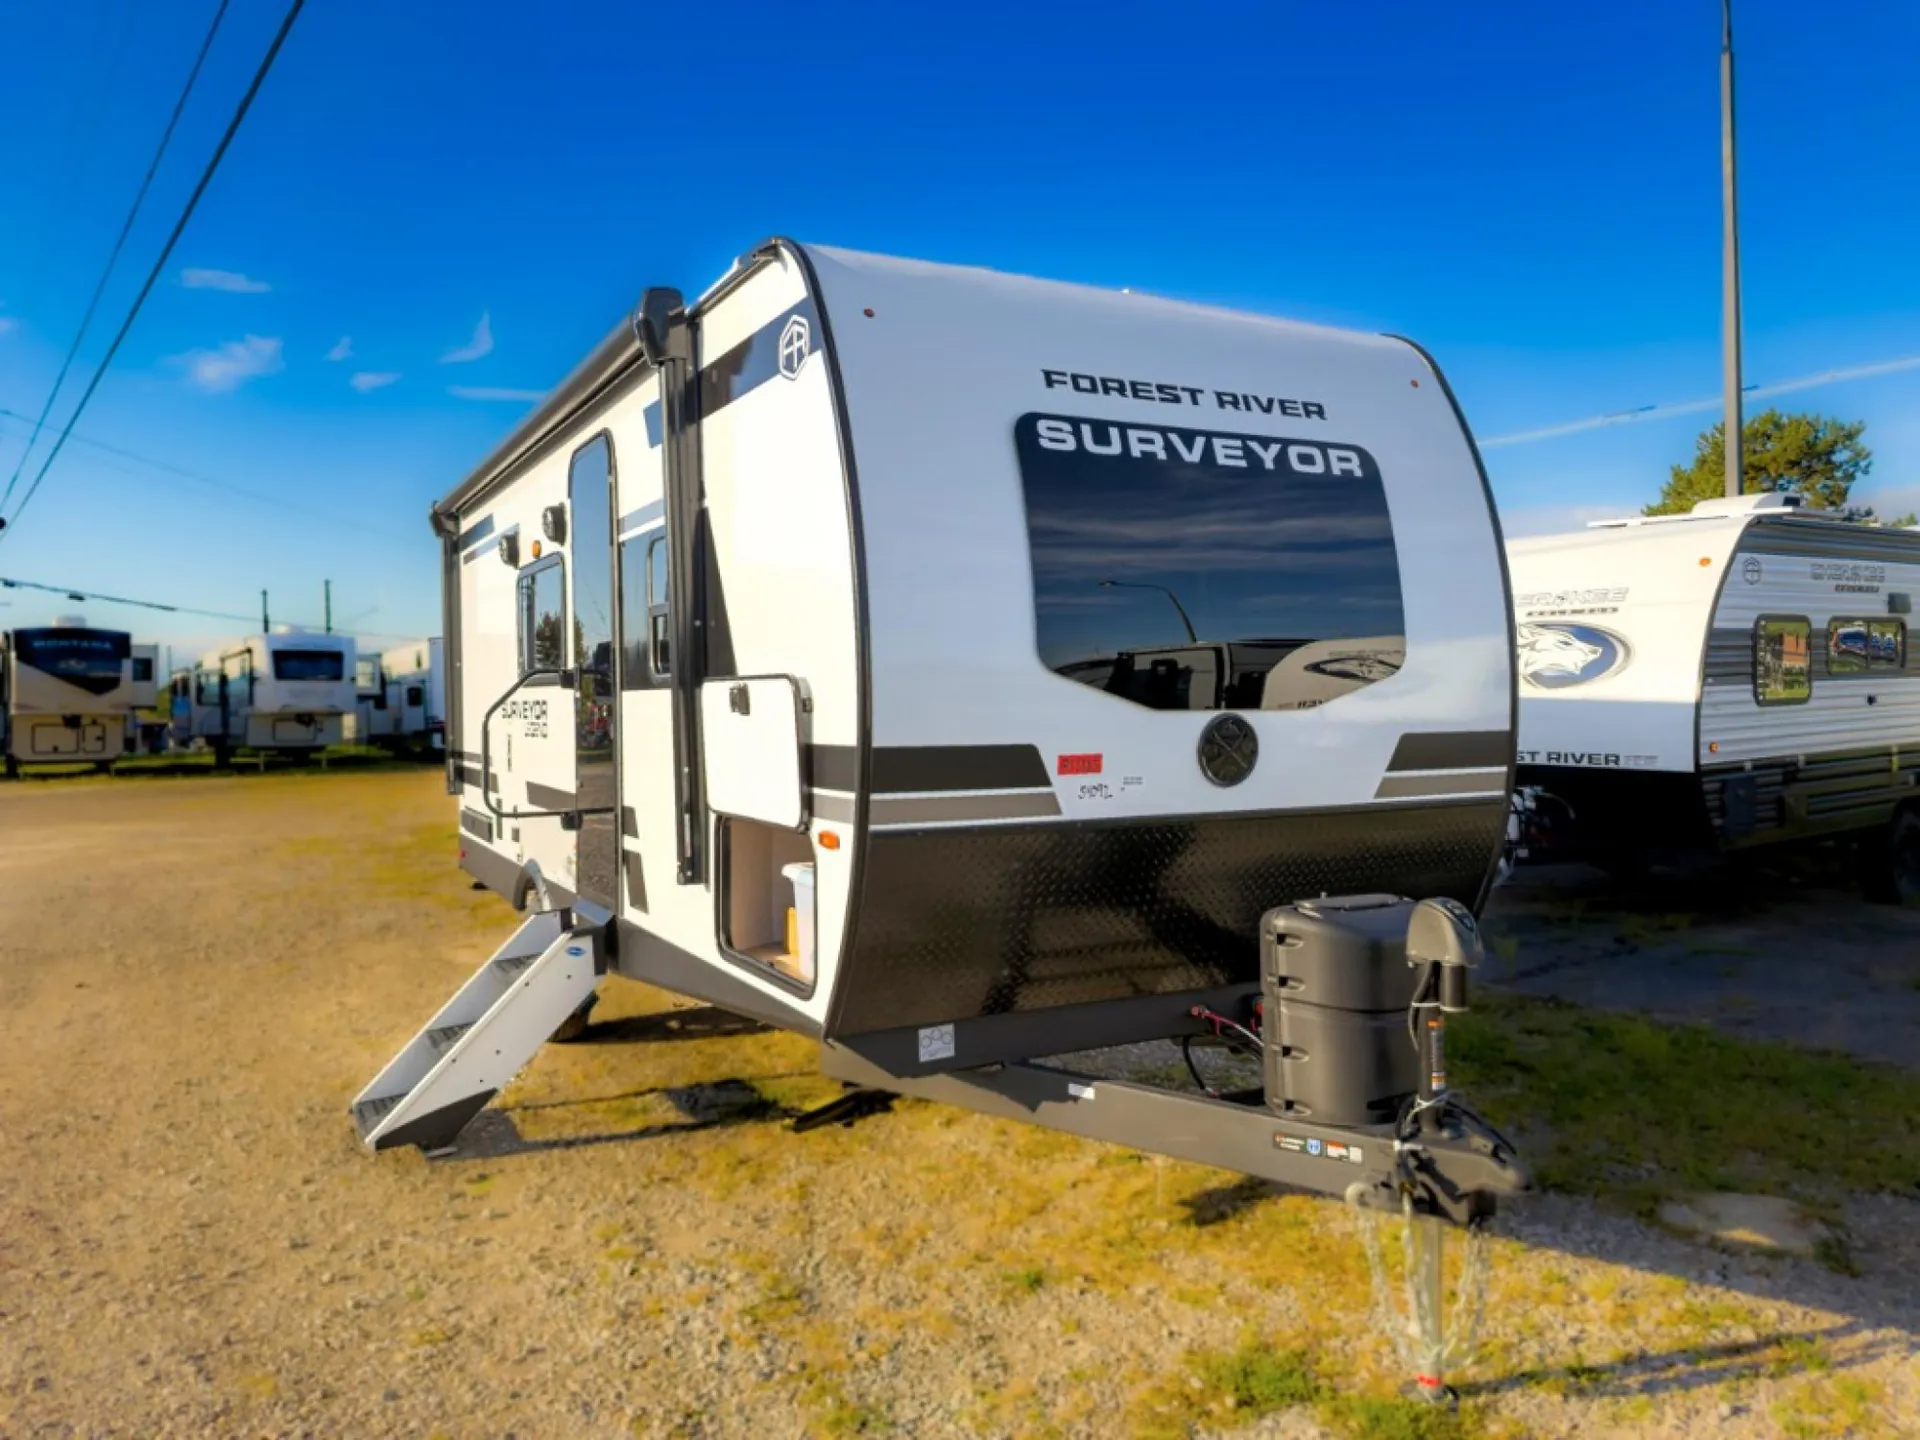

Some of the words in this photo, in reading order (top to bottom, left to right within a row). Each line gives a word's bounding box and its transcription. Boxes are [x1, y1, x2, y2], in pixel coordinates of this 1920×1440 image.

[1041, 369, 1204, 406] FOREST
[1213, 390, 1328, 420] RIVER
[1036, 419, 1364, 478] SURVEYOR
[1546, 751, 1621, 766] RIVER
